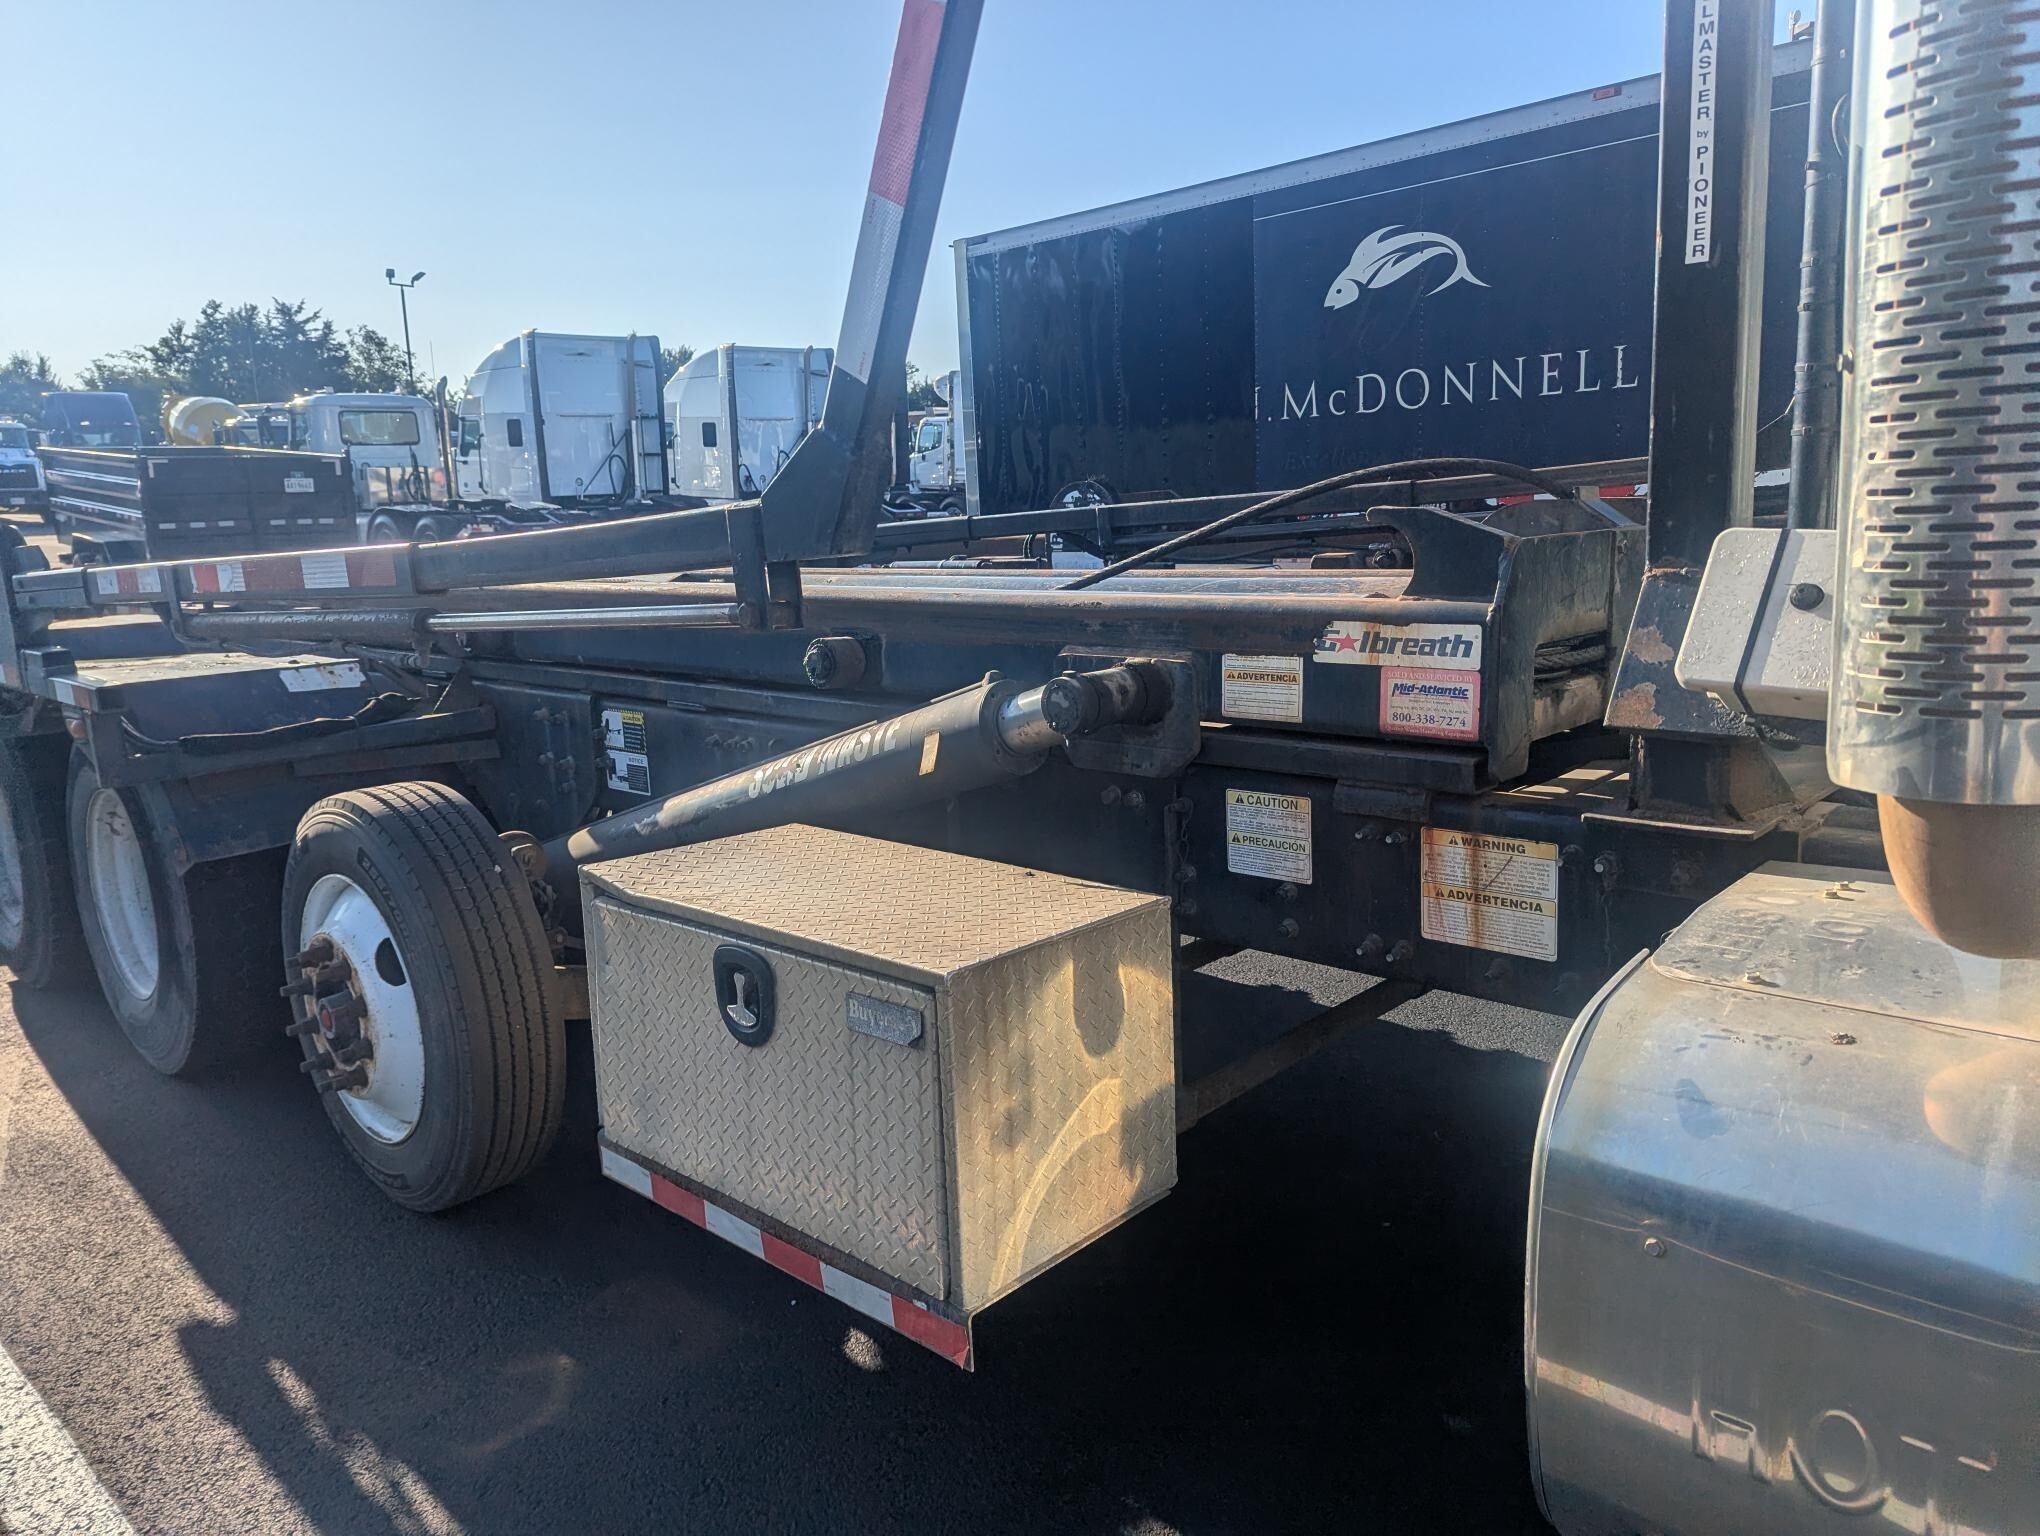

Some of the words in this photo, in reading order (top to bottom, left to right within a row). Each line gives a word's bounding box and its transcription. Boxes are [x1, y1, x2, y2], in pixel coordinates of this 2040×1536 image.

[1697, 0, 1715, 120] LMASTER
[1696, 130, 1709, 139] by
[1692, 146, 1709, 258] PIONEER
[1236, 672, 1297, 683] ADVERTENCIA
[1391, 682, 1469, 698] Mid-Atlantic
[1392, 711, 1466, 727] 800-338-7274
[1246, 794, 1298, 811] CAUTION
[1242, 835, 1306, 852] PRECAUCIÓN
[1461, 836, 1526, 854] WARNING
[1447, 888, 1543, 913] ADVERTENCIA
